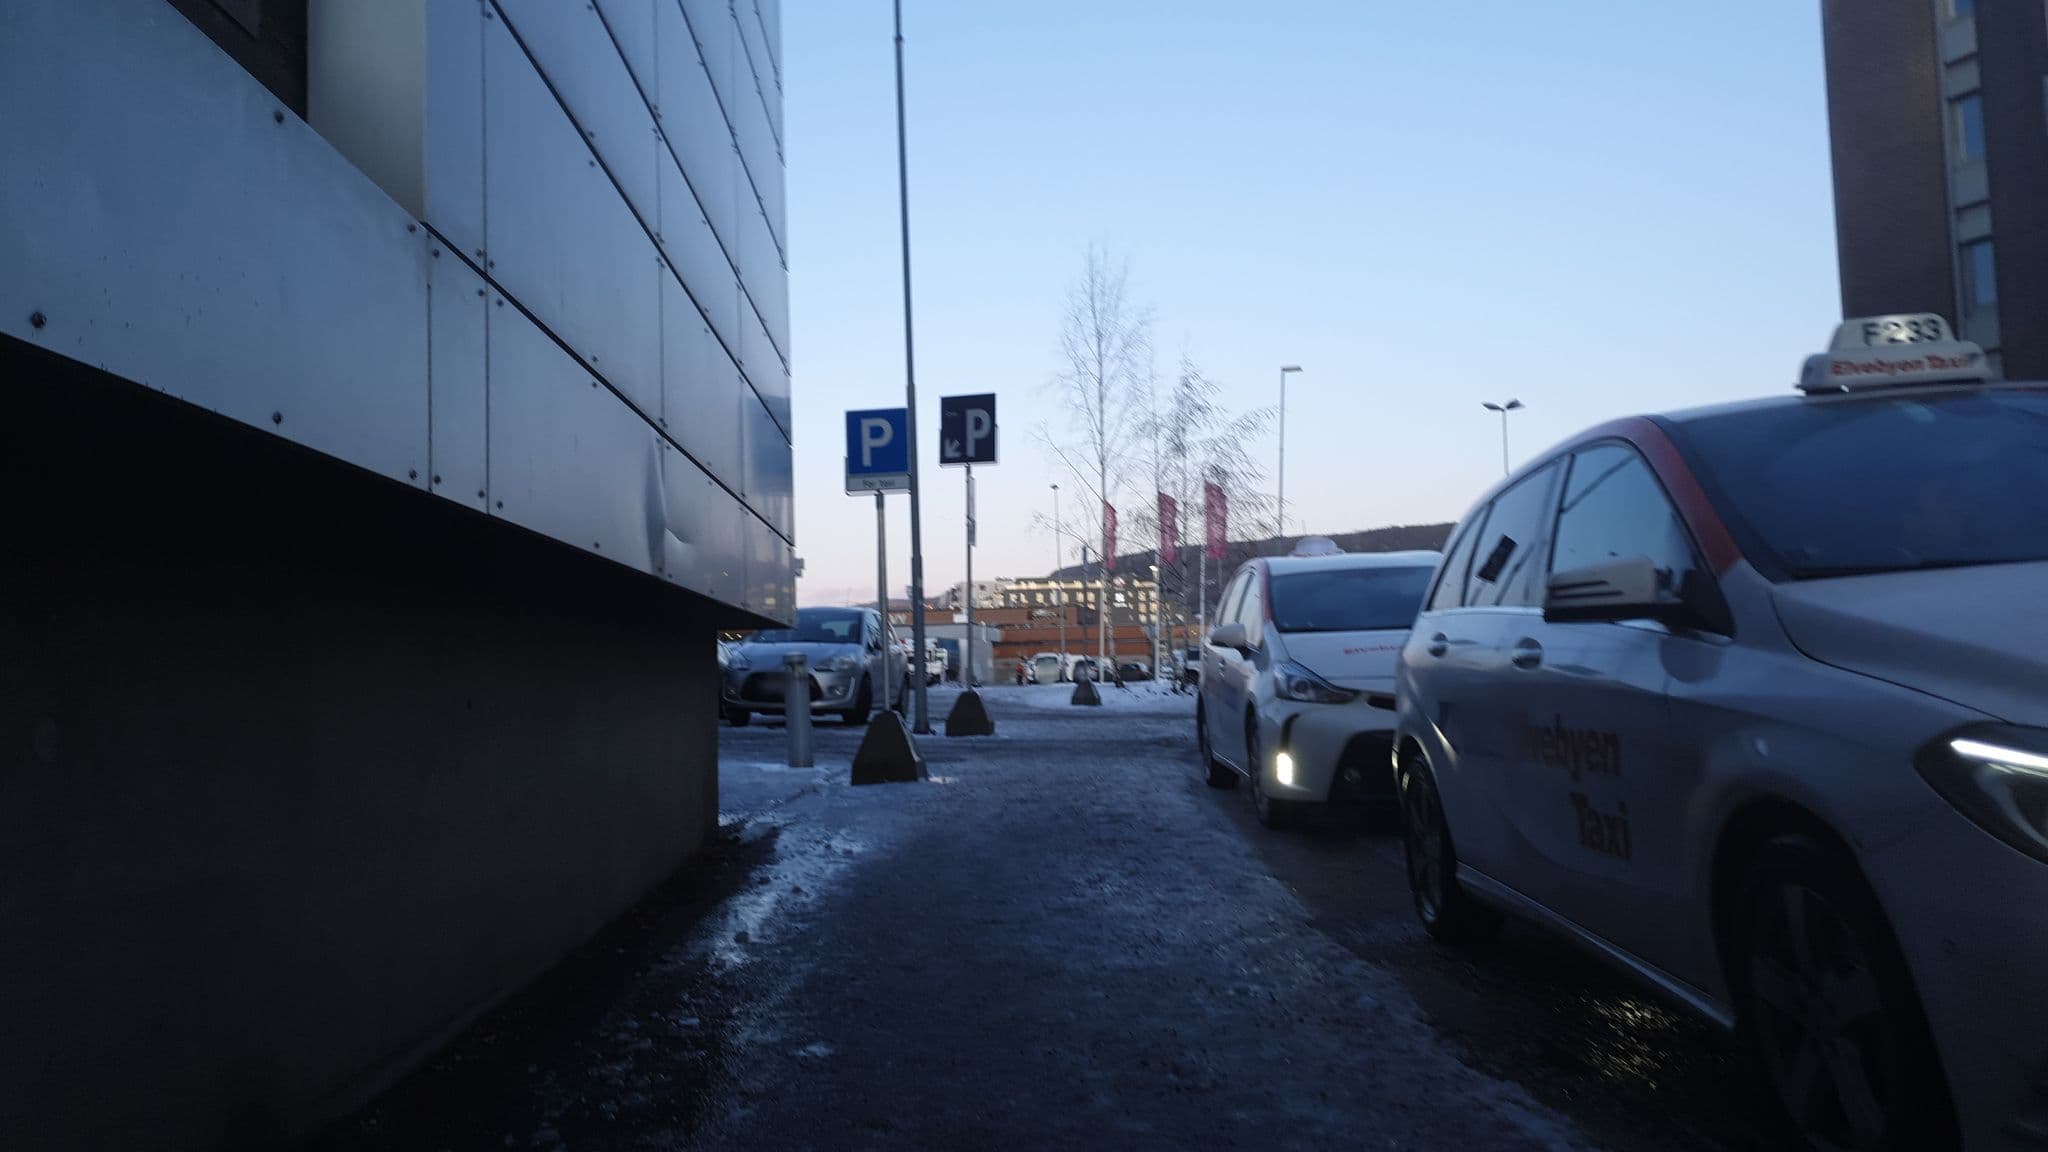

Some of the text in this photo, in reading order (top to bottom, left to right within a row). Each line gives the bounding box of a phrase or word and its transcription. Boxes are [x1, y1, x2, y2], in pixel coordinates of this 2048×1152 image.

[861, 418, 893, 467] P
[966, 409, 991, 457] P
[1510, 712, 1621, 783] lvebyen
[1568, 792, 1632, 861] Taxi
